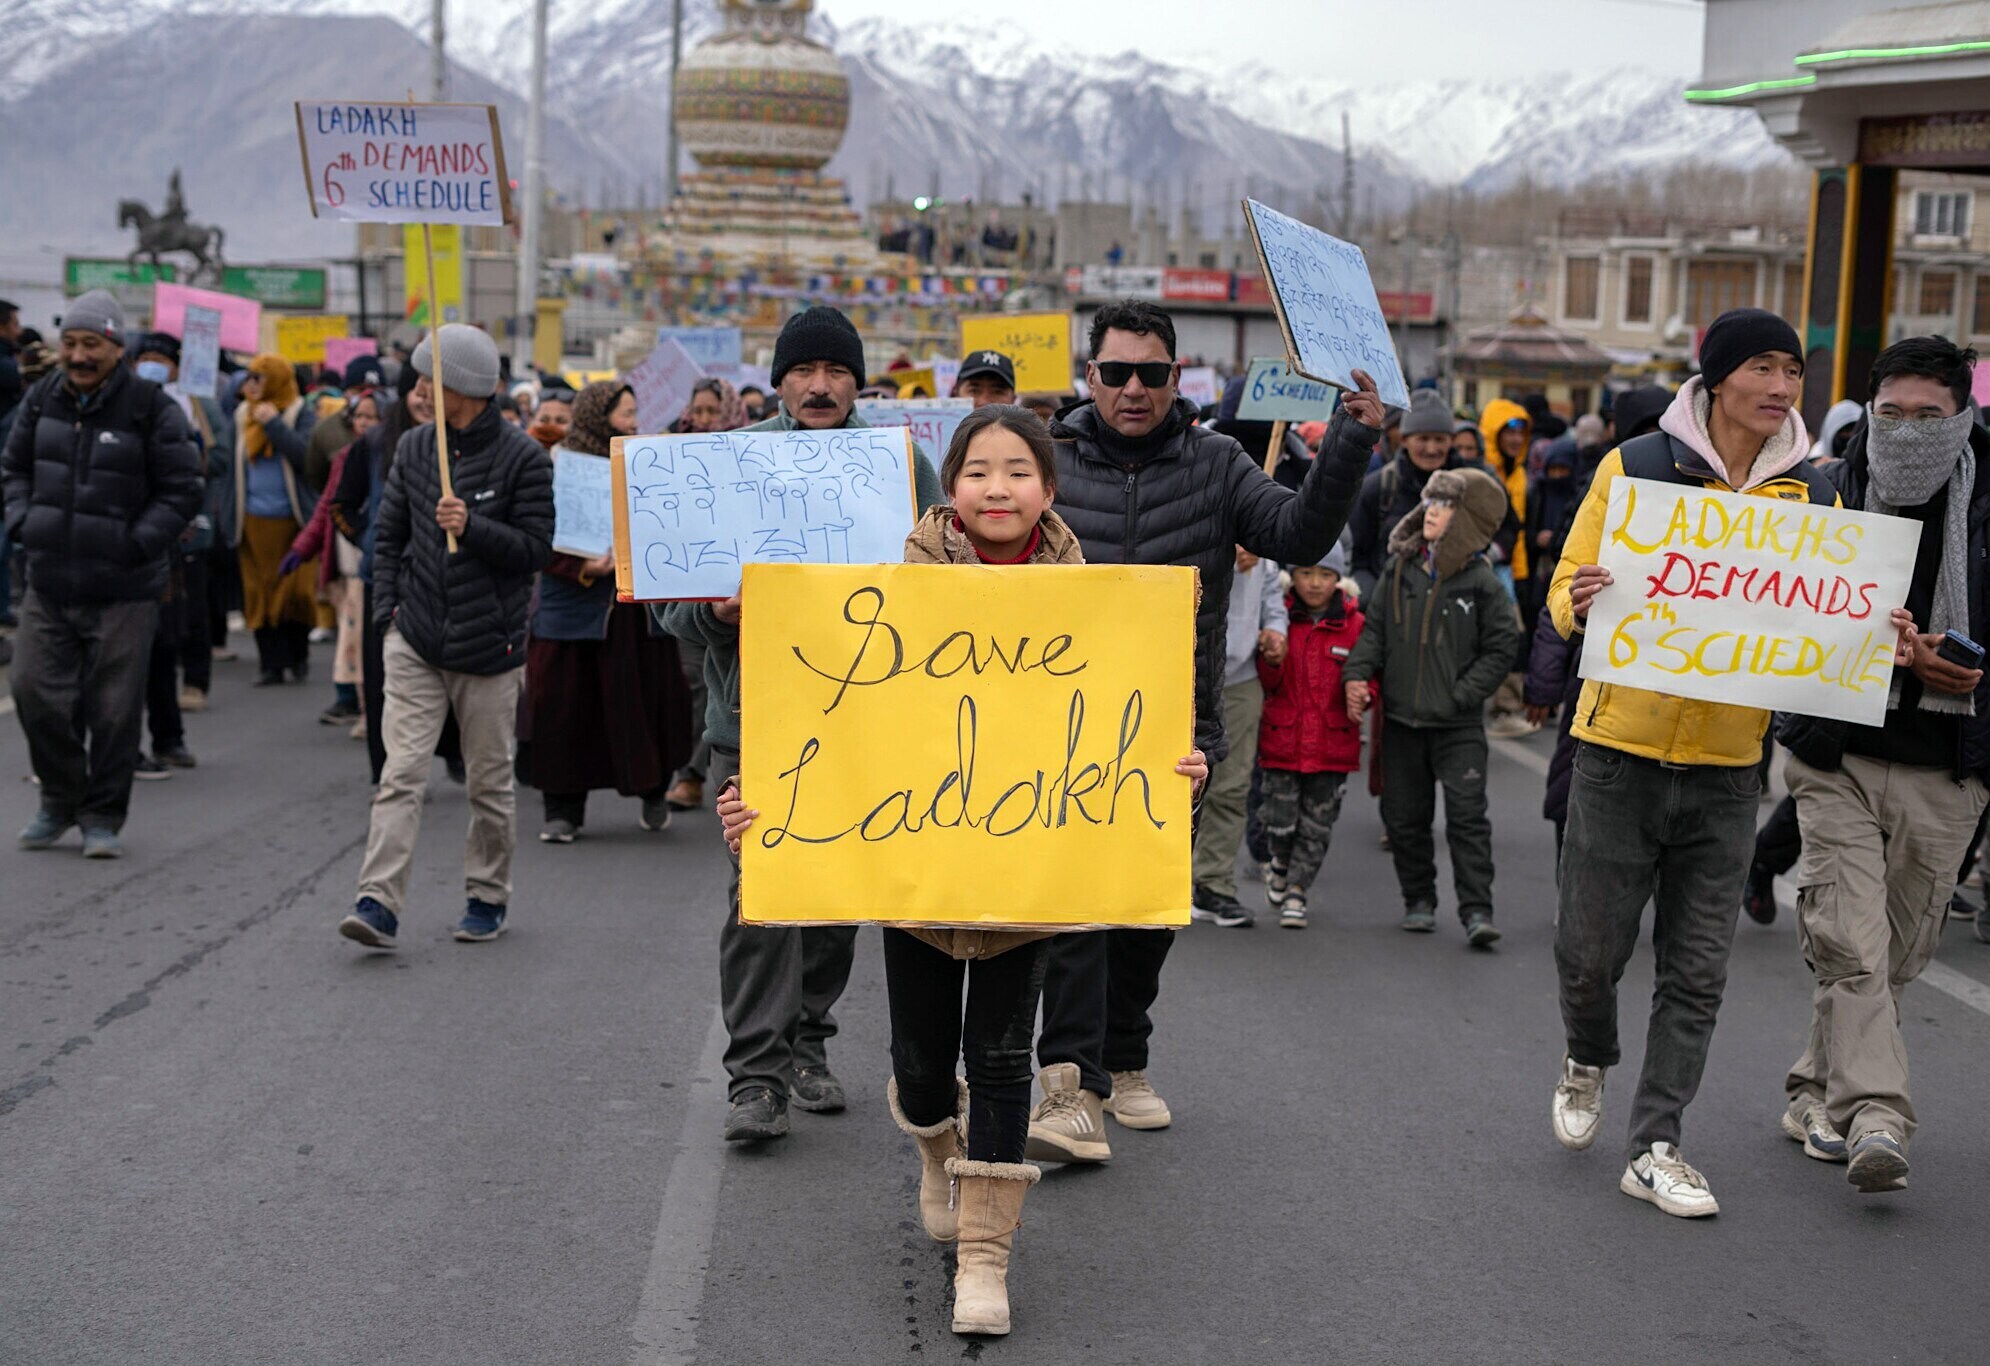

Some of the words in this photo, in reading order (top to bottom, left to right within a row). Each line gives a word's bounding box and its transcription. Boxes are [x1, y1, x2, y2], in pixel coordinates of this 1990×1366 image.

[317, 105, 416, 137] LADAKH
[324, 152, 357, 208] 6th
[368, 179, 494, 212] SCHEDULE
[363, 141, 489, 176] DEMANDS
[1612, 484, 1865, 565] LADAKHS
[1645, 552, 1879, 620] DEMANDS
[791, 586, 1089, 715] Save
[1647, 626, 1892, 694] SCHEDULE
[761, 688, 1167, 849] Ladakh
